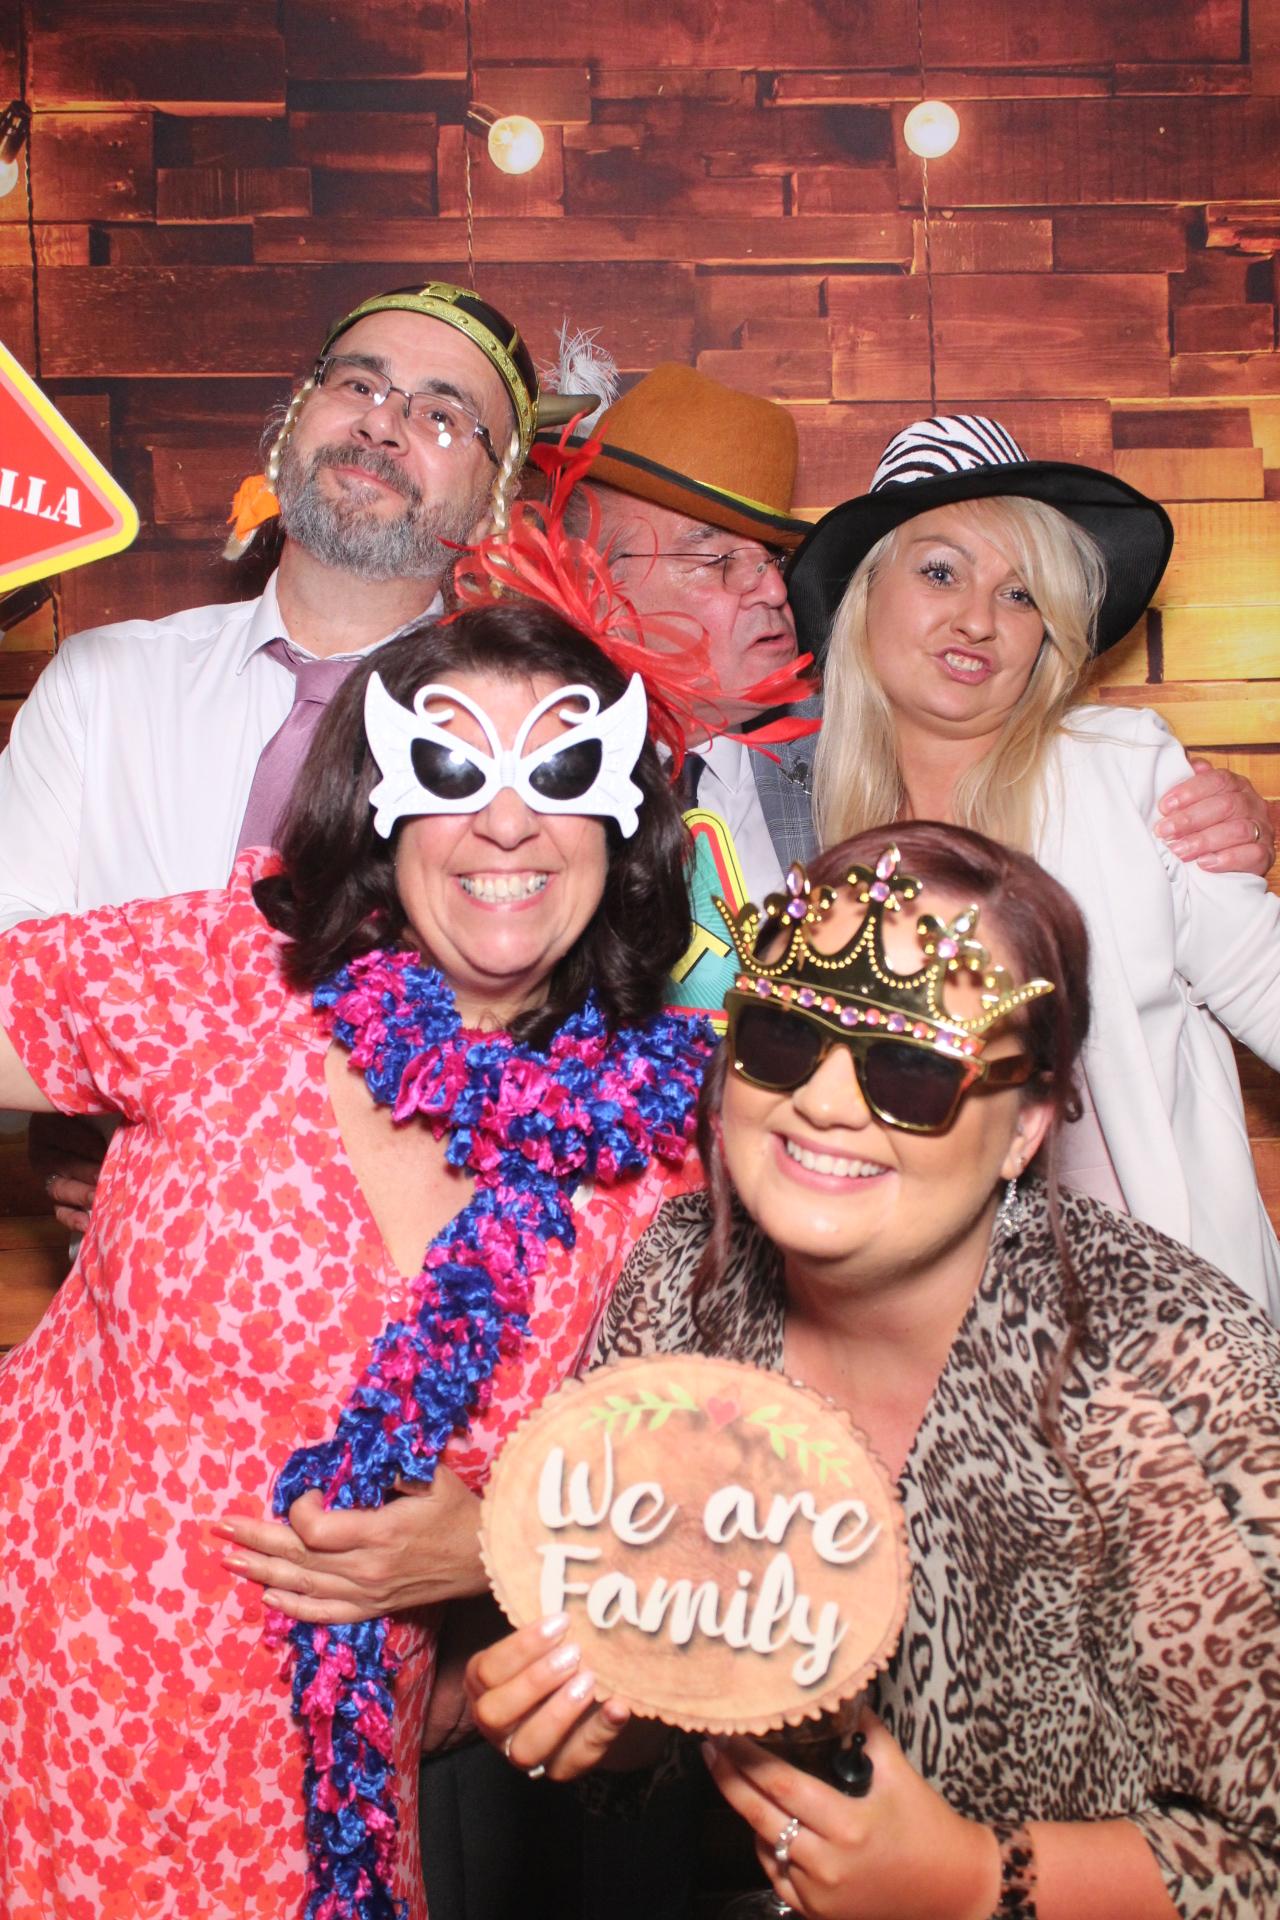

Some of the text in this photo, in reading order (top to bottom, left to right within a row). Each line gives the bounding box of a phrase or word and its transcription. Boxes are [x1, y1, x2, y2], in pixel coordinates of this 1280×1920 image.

[538, 1431, 883, 1565] We are
[536, 1543, 849, 1687] Family
